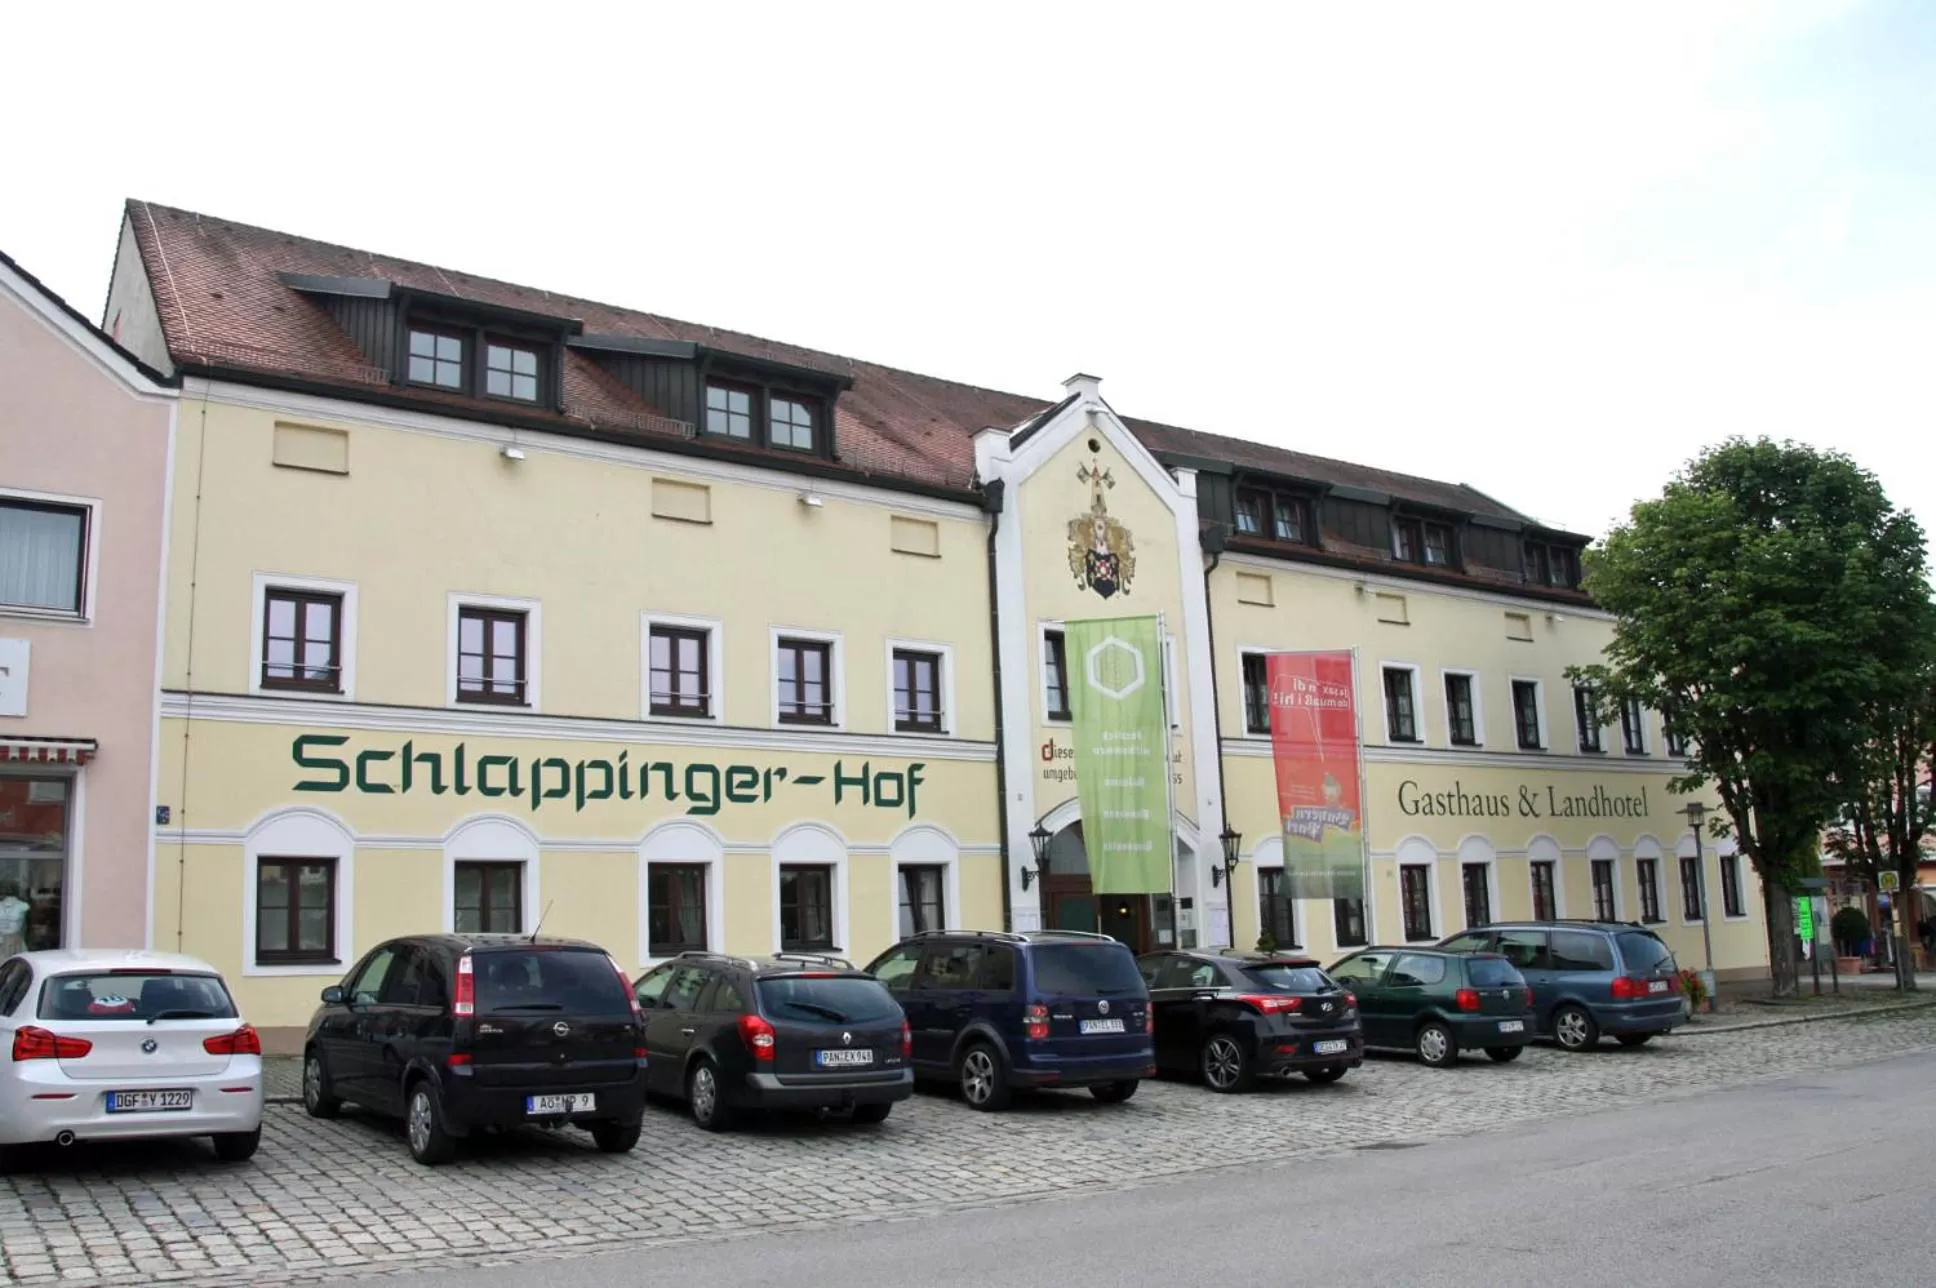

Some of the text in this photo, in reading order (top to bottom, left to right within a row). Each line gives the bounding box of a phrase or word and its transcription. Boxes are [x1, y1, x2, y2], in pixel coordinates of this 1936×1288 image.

[292, 734, 926, 820] Schlappinger-Hof
[1398, 780, 1648, 818] Gasthaus & Landhotel
[116, 1092, 190, 1108] DGF Y 1229
